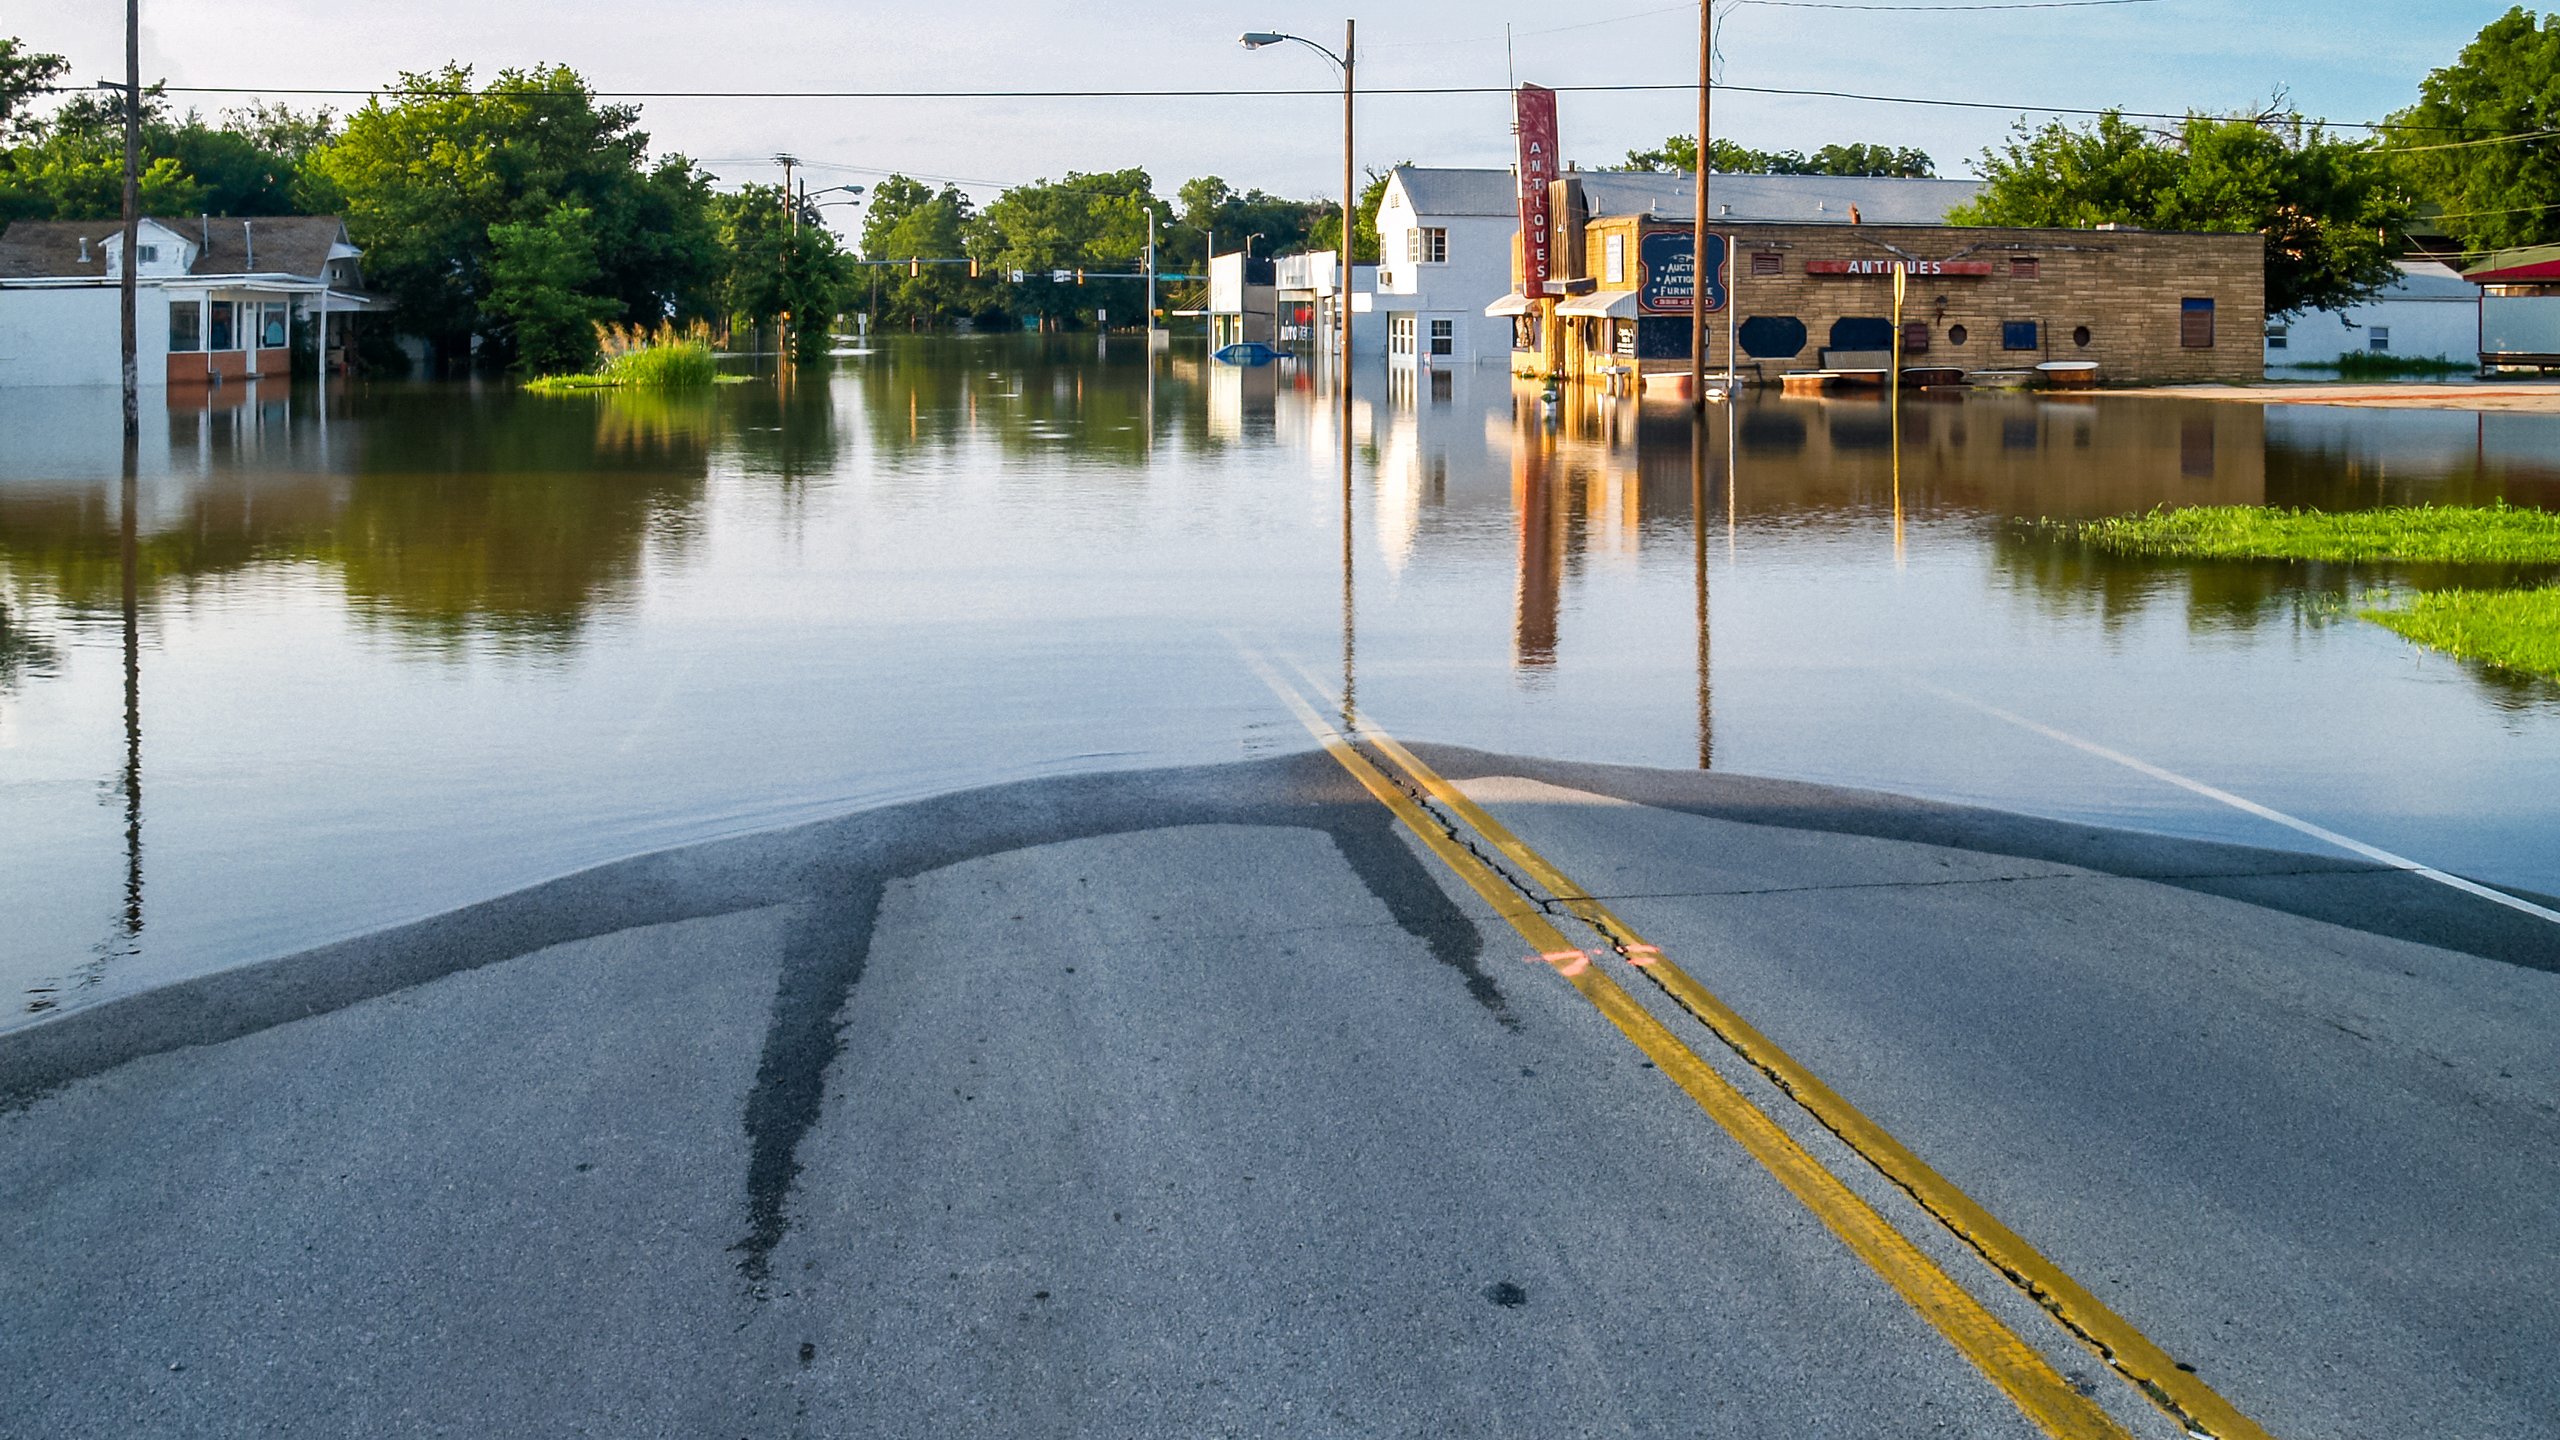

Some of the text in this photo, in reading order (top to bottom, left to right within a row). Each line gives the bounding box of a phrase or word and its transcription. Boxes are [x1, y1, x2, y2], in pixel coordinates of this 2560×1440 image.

[1530, 142, 1545, 277] ANTIQUES
[1847, 260, 1941, 274] ANTIUES
[1664, 275, 1709, 285] ANTIQS
[1660, 286, 1713, 296] FURNITE
